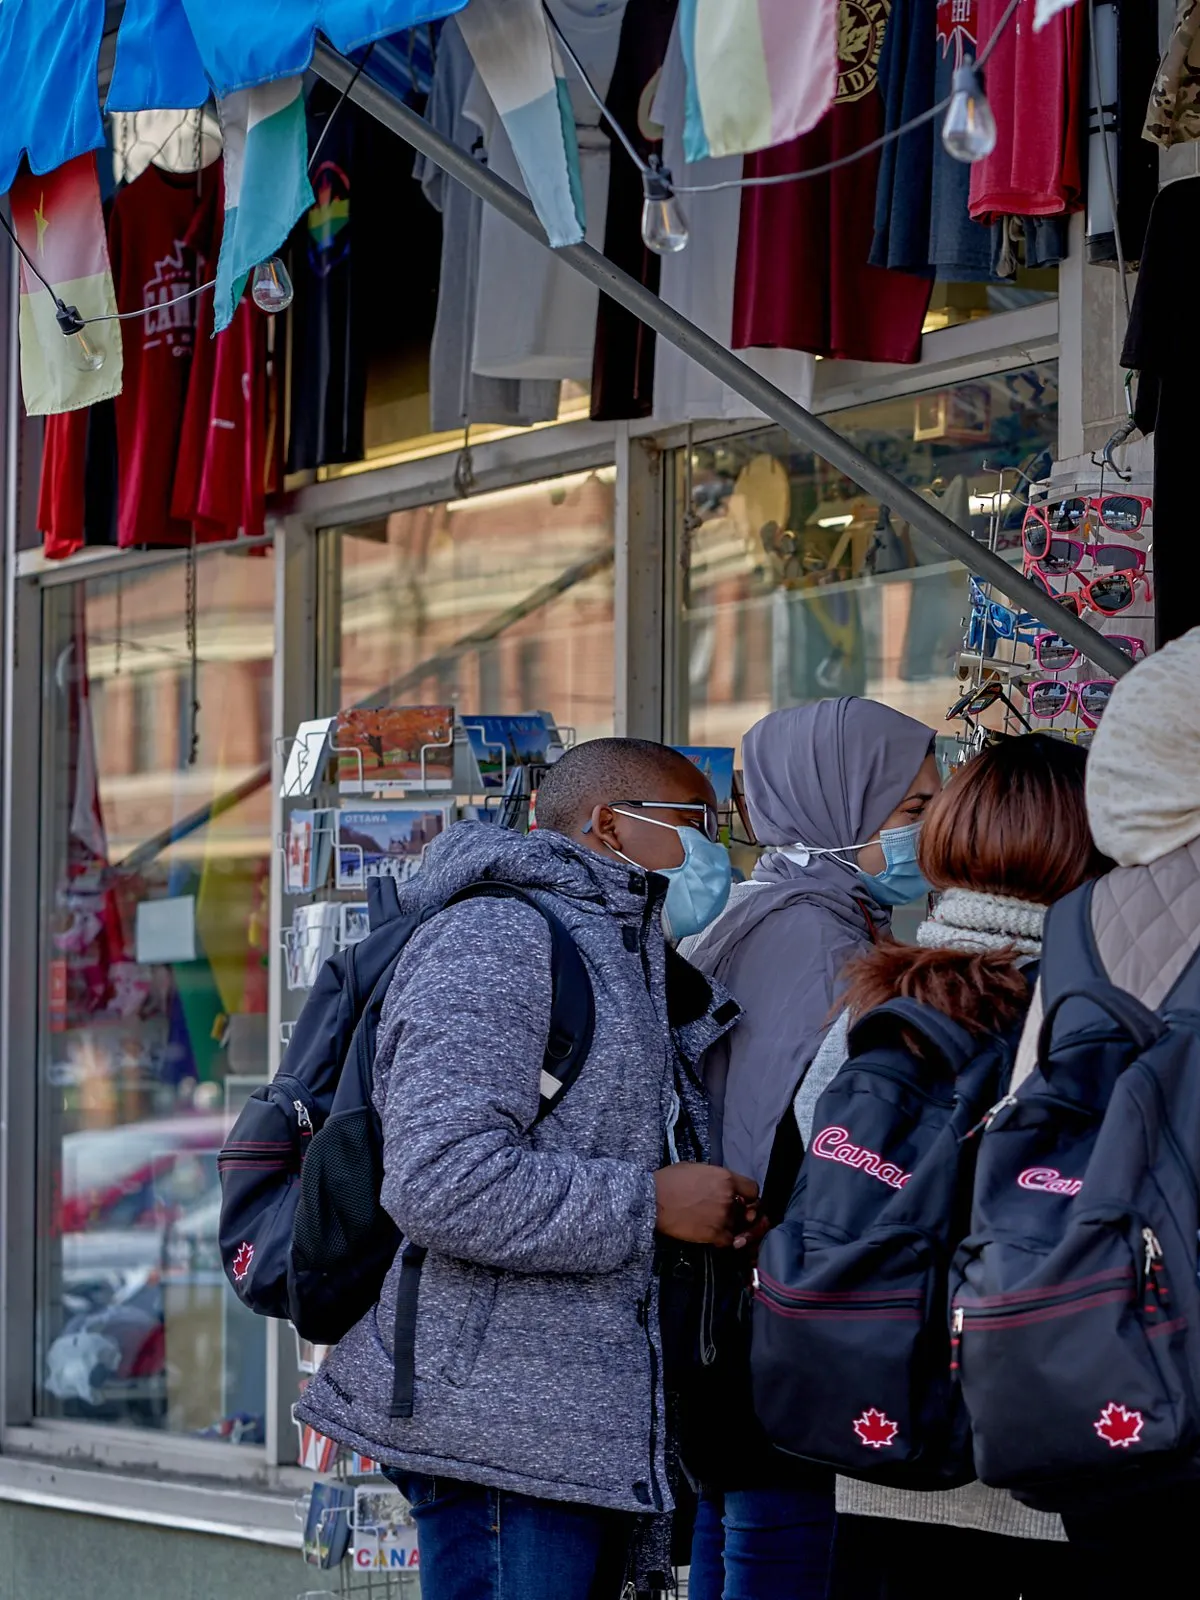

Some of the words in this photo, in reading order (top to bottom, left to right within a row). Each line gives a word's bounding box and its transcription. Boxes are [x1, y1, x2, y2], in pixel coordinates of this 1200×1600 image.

[144, 283, 191, 336] CAN
[345, 814, 388, 824] OTTAWA
[812, 1126, 912, 1190] Cana
[357, 1548, 419, 1568] CANA
